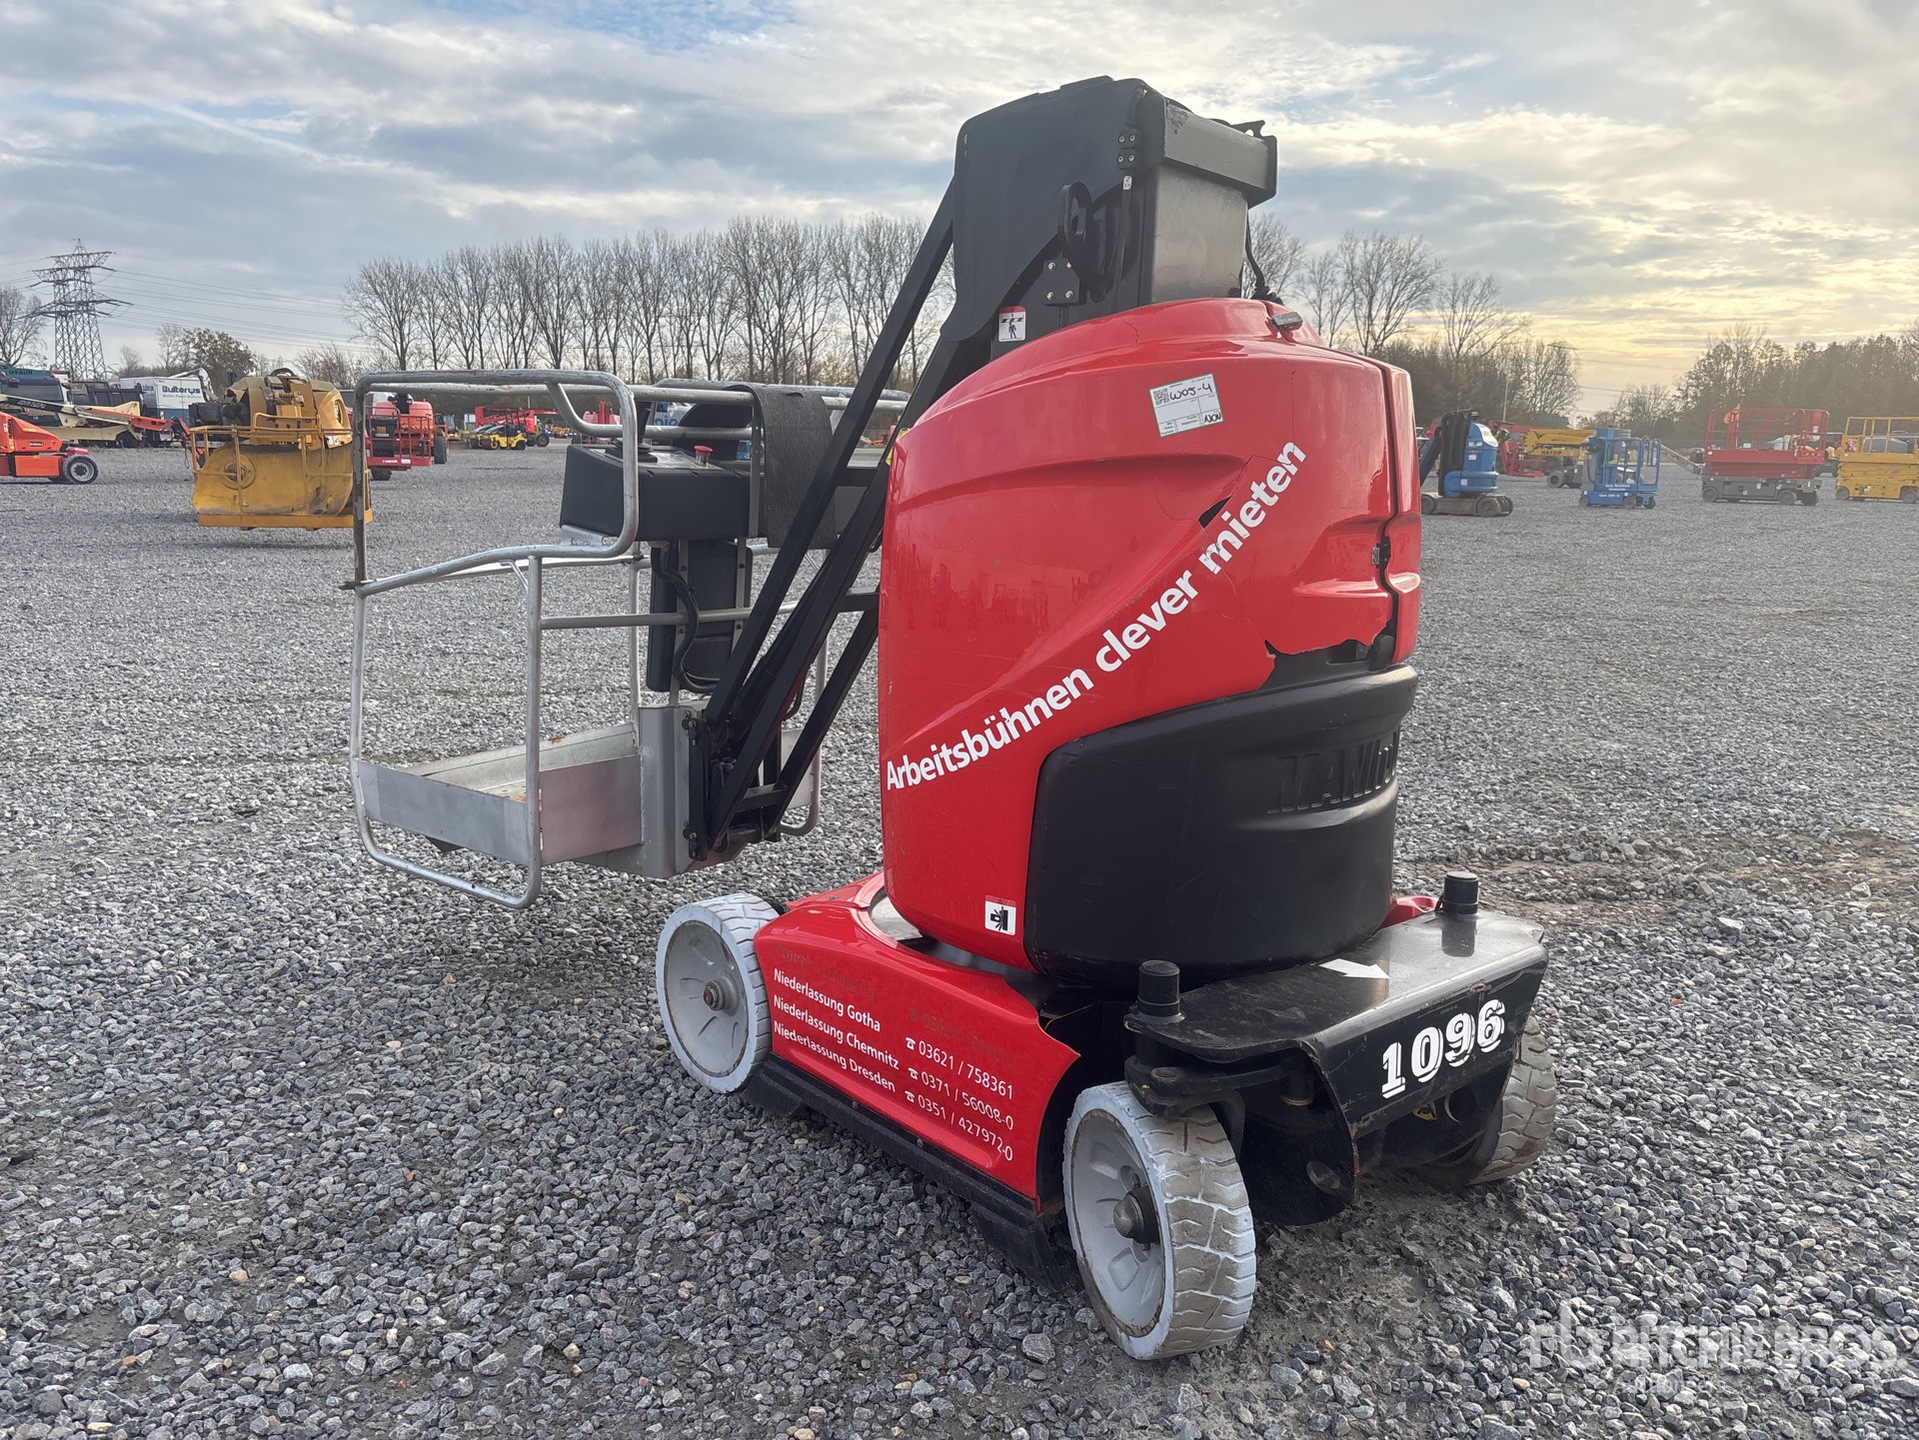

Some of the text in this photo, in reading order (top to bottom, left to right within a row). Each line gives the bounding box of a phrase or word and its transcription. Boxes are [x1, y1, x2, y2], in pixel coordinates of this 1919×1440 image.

[886, 441, 1306, 791] Arbeitsbühnen clever mieten
[774, 968, 844, 1017] Niederlassung
[847, 1005, 881, 1032] Gotha
[918, 1040, 954, 1070] 03621
[958, 1061, 964, 1076] /
[967, 1063, 1013, 1100] 758361
[774, 994, 844, 1044] Niederlassung
[846, 1033, 900, 1070] Chemnitz
[921, 1071, 950, 1097] 0371
[962, 1091, 1014, 1131] 56008-0
[774, 1020, 847, 1070] Niederlassung
[849, 1058, 896, 1093] Dresden
[918, 1094, 946, 1120] 0351
[959, 1117, 1013, 1161] 427972-0
[1382, 999, 1506, 1099] 1096
